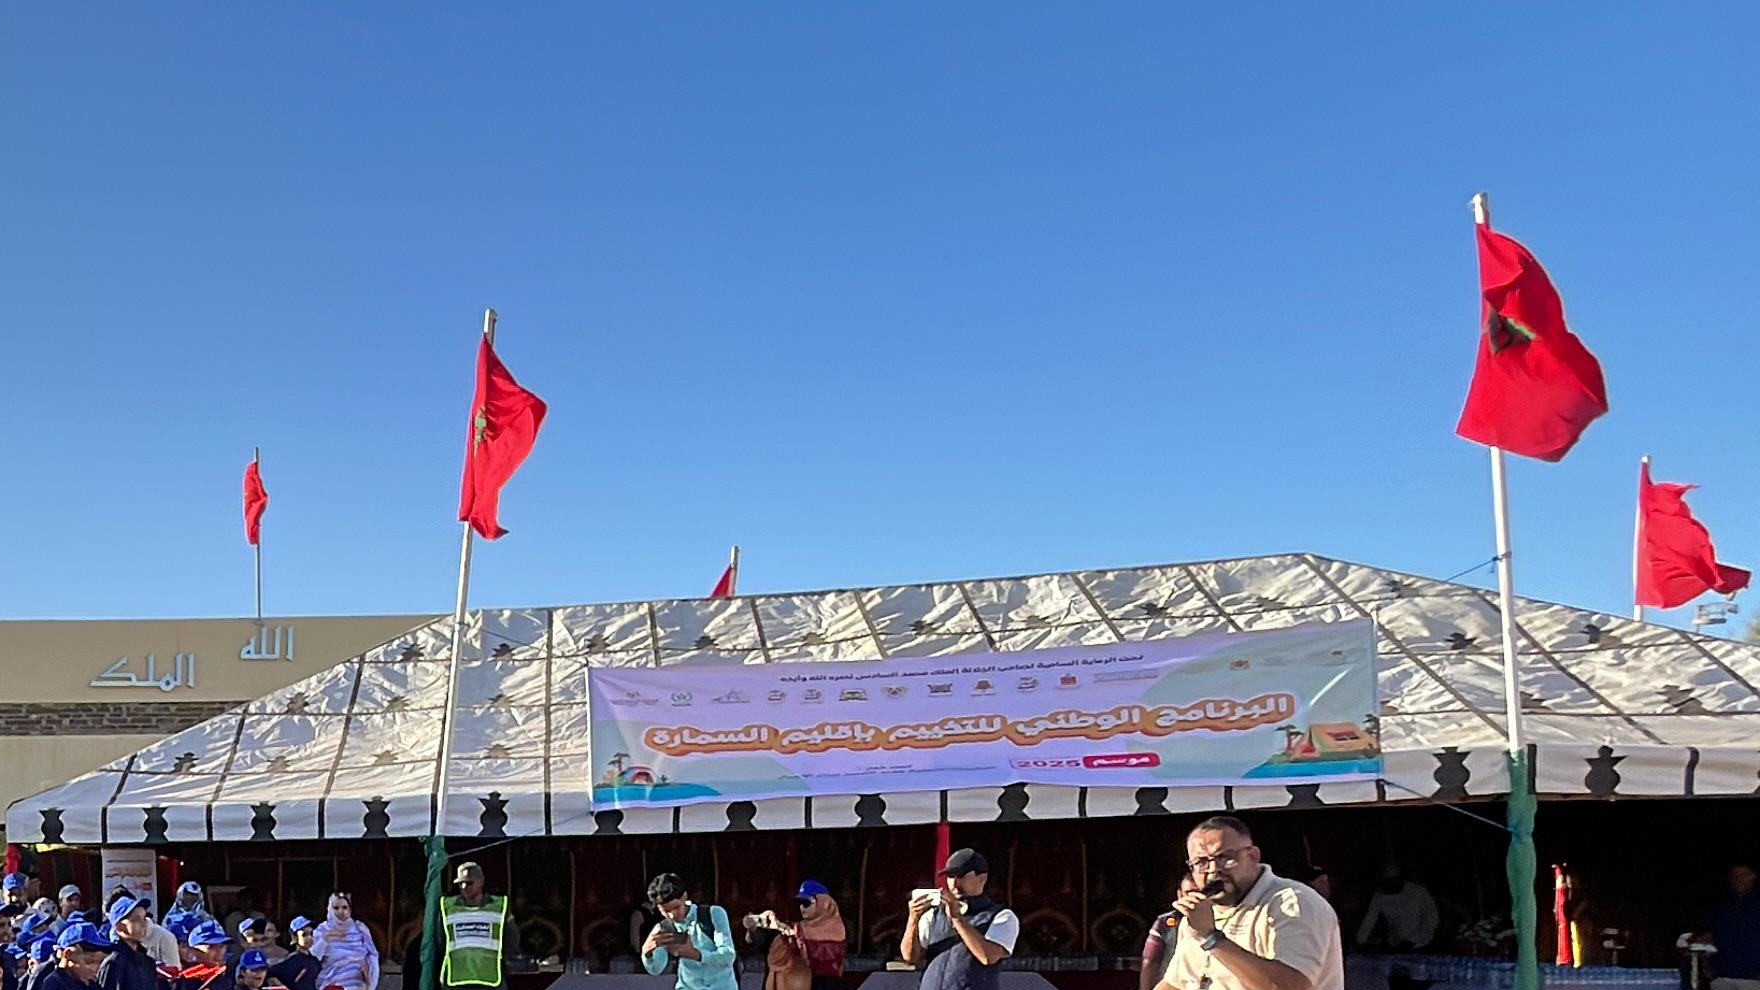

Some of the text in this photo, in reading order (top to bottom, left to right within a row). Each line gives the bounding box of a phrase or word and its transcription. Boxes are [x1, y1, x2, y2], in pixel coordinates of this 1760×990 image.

[240, 625, 293, 662] الله
[90, 653, 195, 692] الملك
[652, 696, 1287, 747] البرنامج الوطني للتخييم بإقليم السمارة
[1016, 755, 1151, 769] موسم 2025
